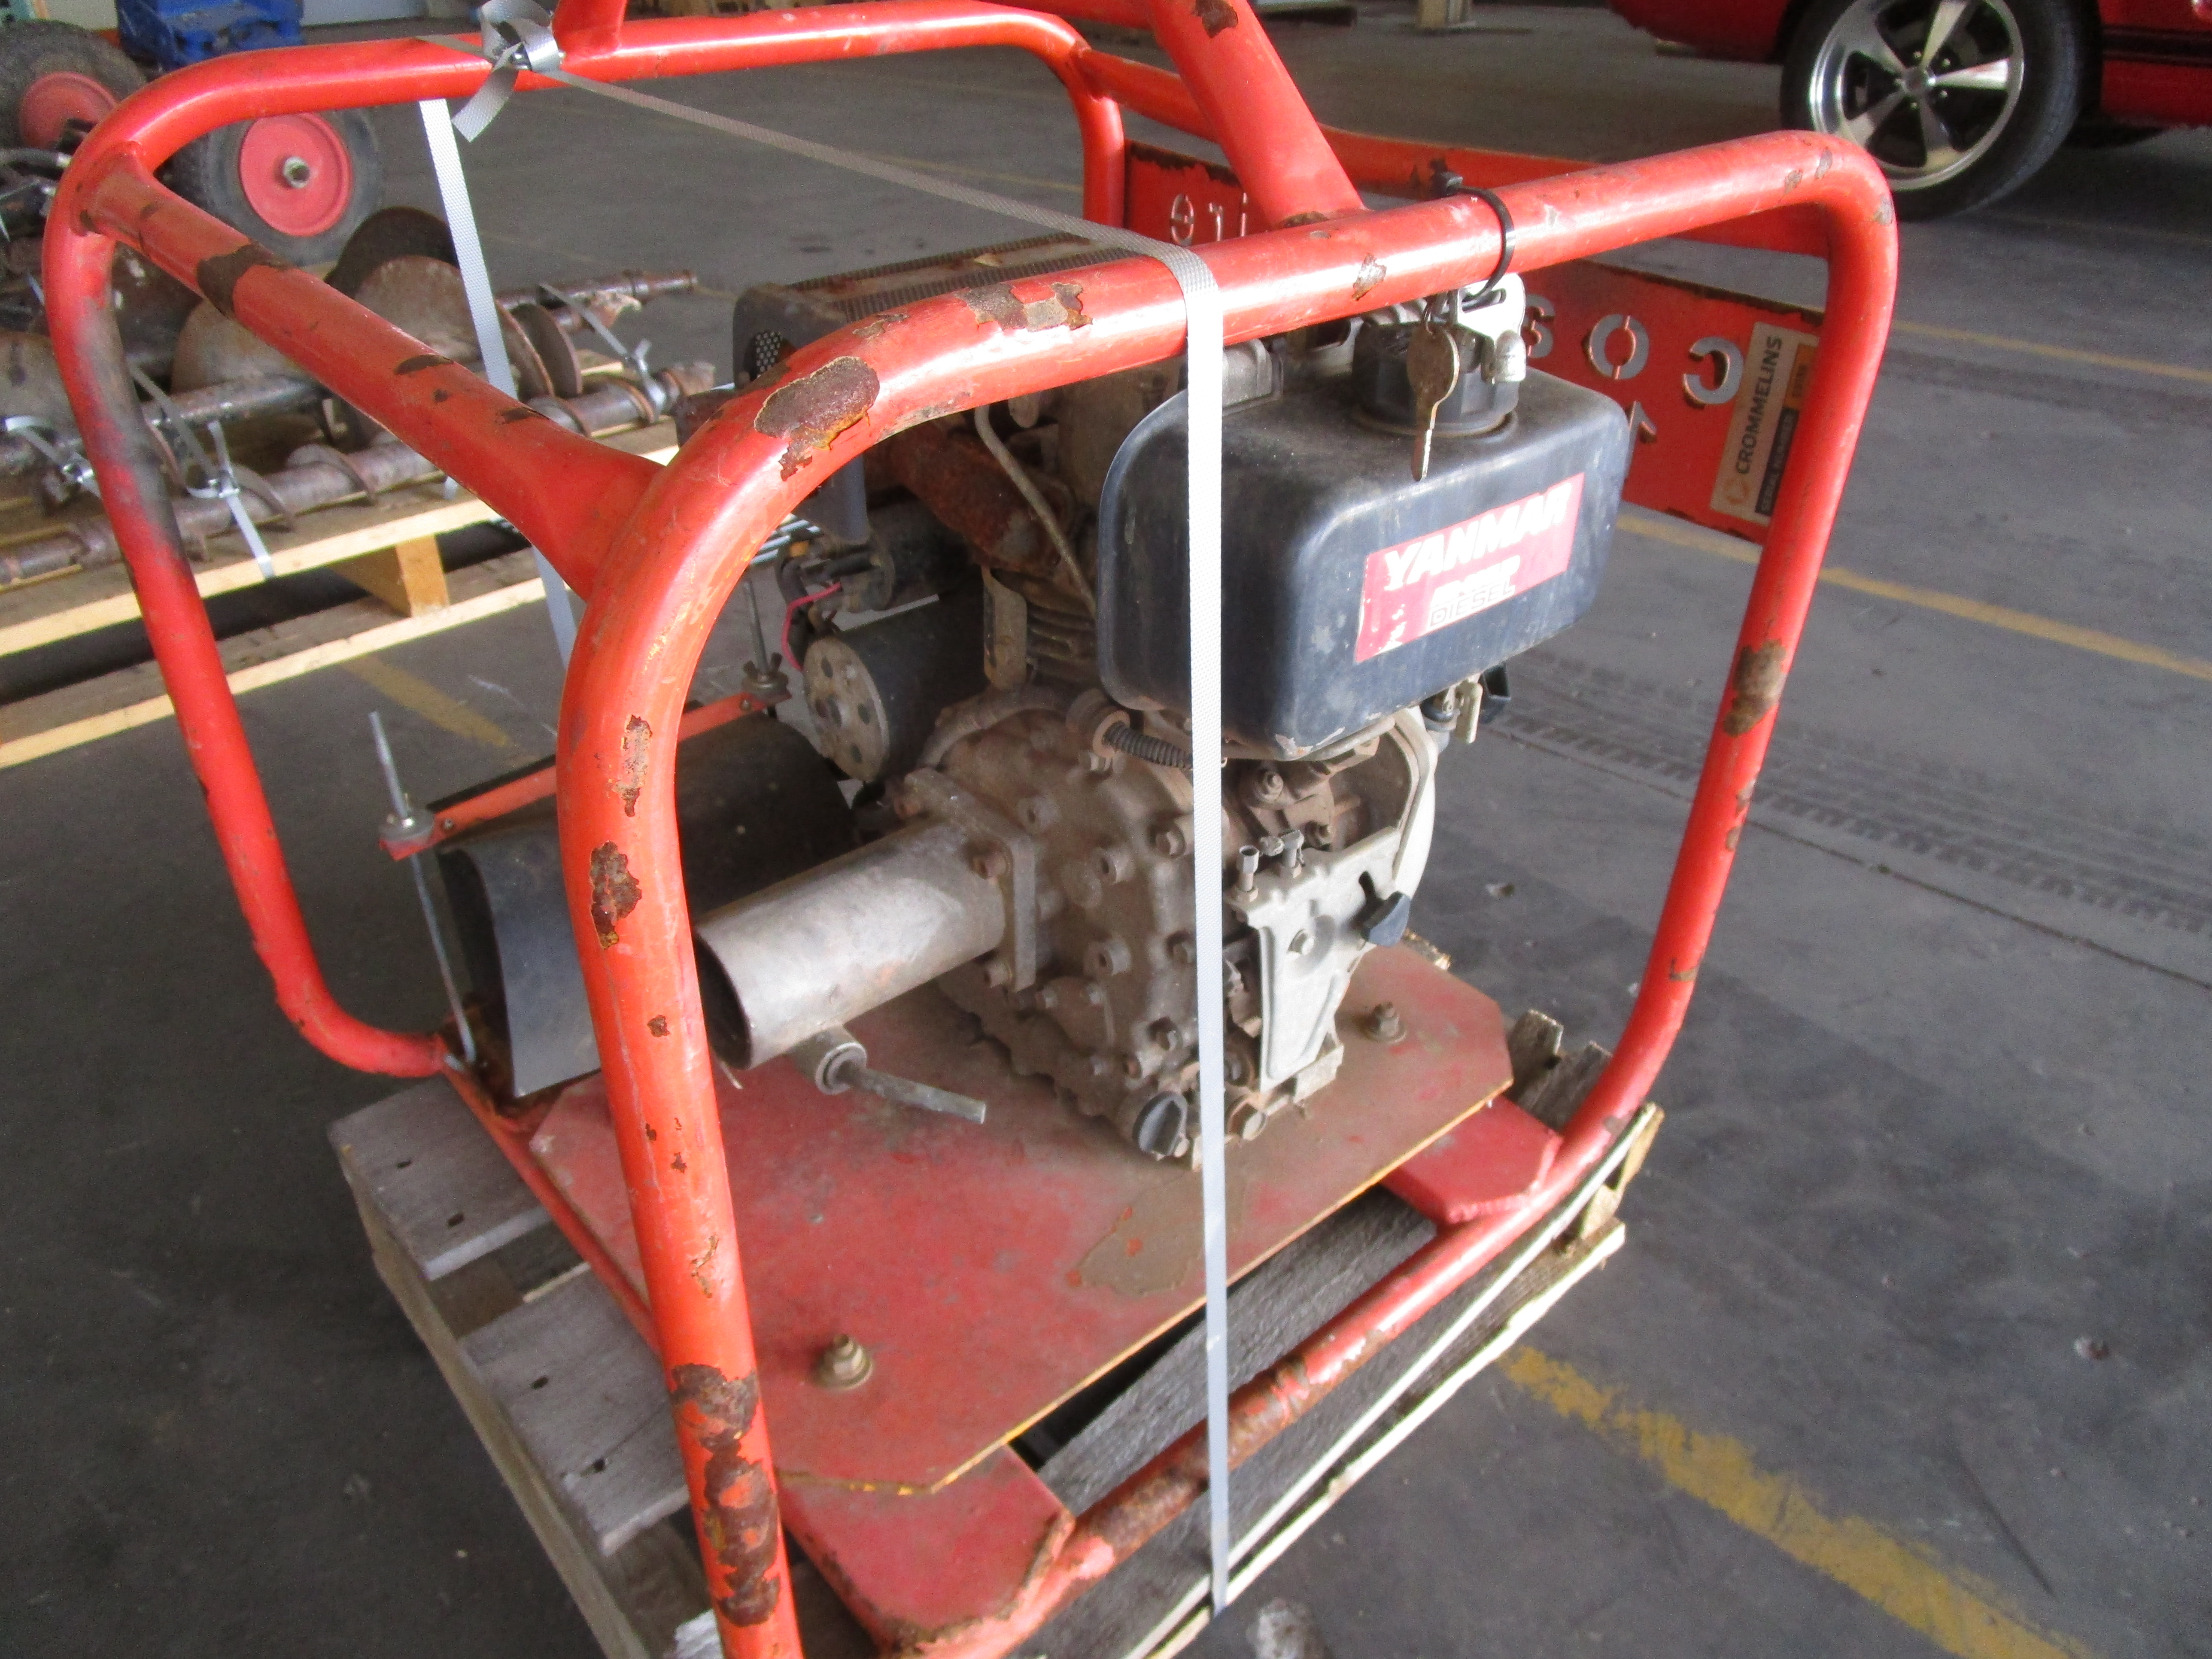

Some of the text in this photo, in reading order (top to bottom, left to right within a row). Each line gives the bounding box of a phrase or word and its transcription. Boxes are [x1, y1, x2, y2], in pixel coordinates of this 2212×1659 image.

[1736, 336, 1783, 475] CROMMELINS
[1383, 481, 1572, 591] YANMAR
[1429, 577, 1516, 627] DIESEL
